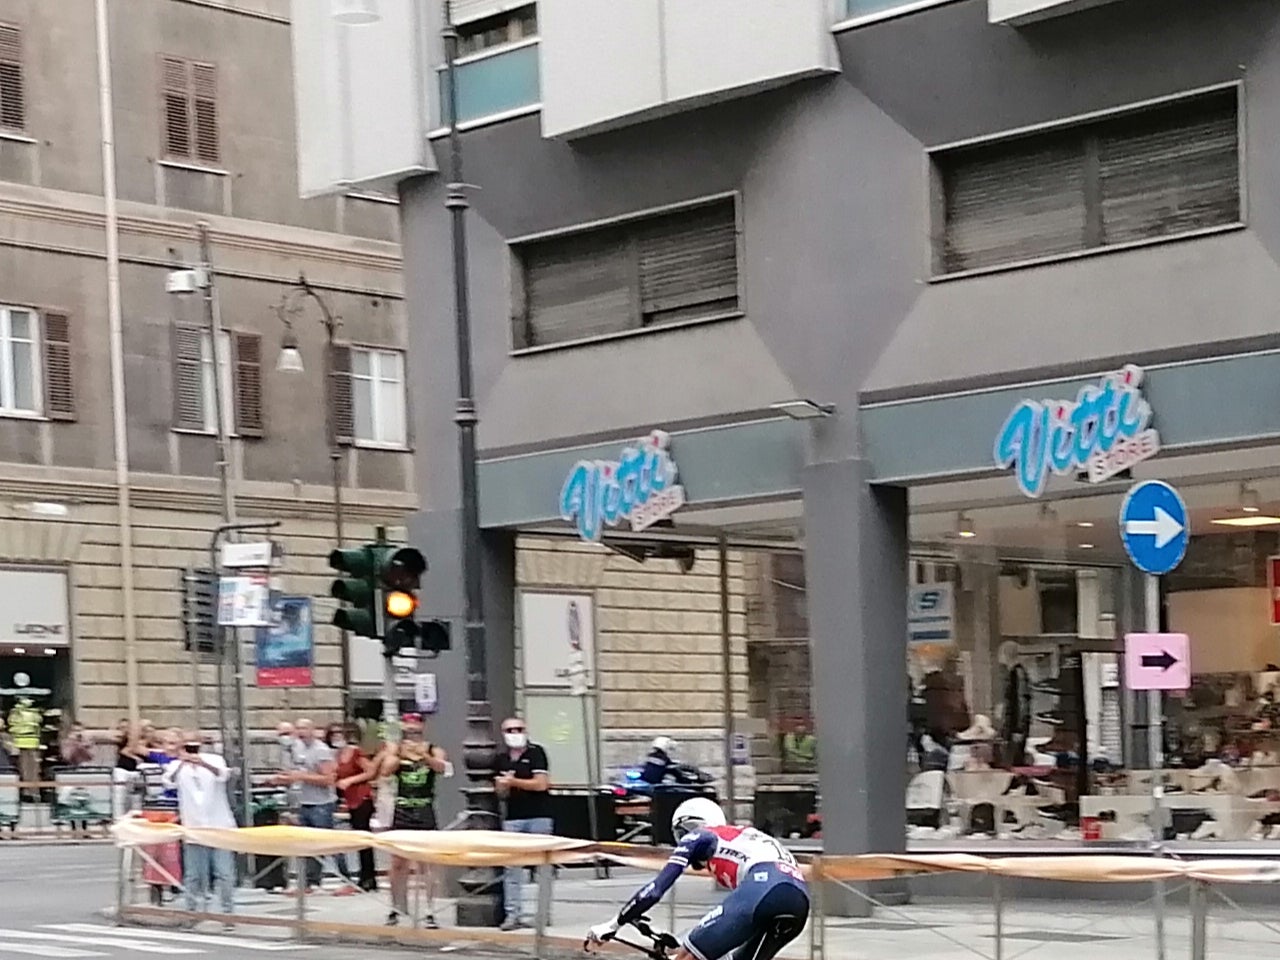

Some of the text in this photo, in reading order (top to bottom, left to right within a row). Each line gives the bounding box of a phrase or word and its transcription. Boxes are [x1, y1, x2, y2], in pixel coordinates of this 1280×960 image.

[996, 366, 1150, 496] Vitti
[1092, 433, 1156, 478] STORE
[561, 431, 673, 541] Vitti
[718, 846, 751, 863] TREK
